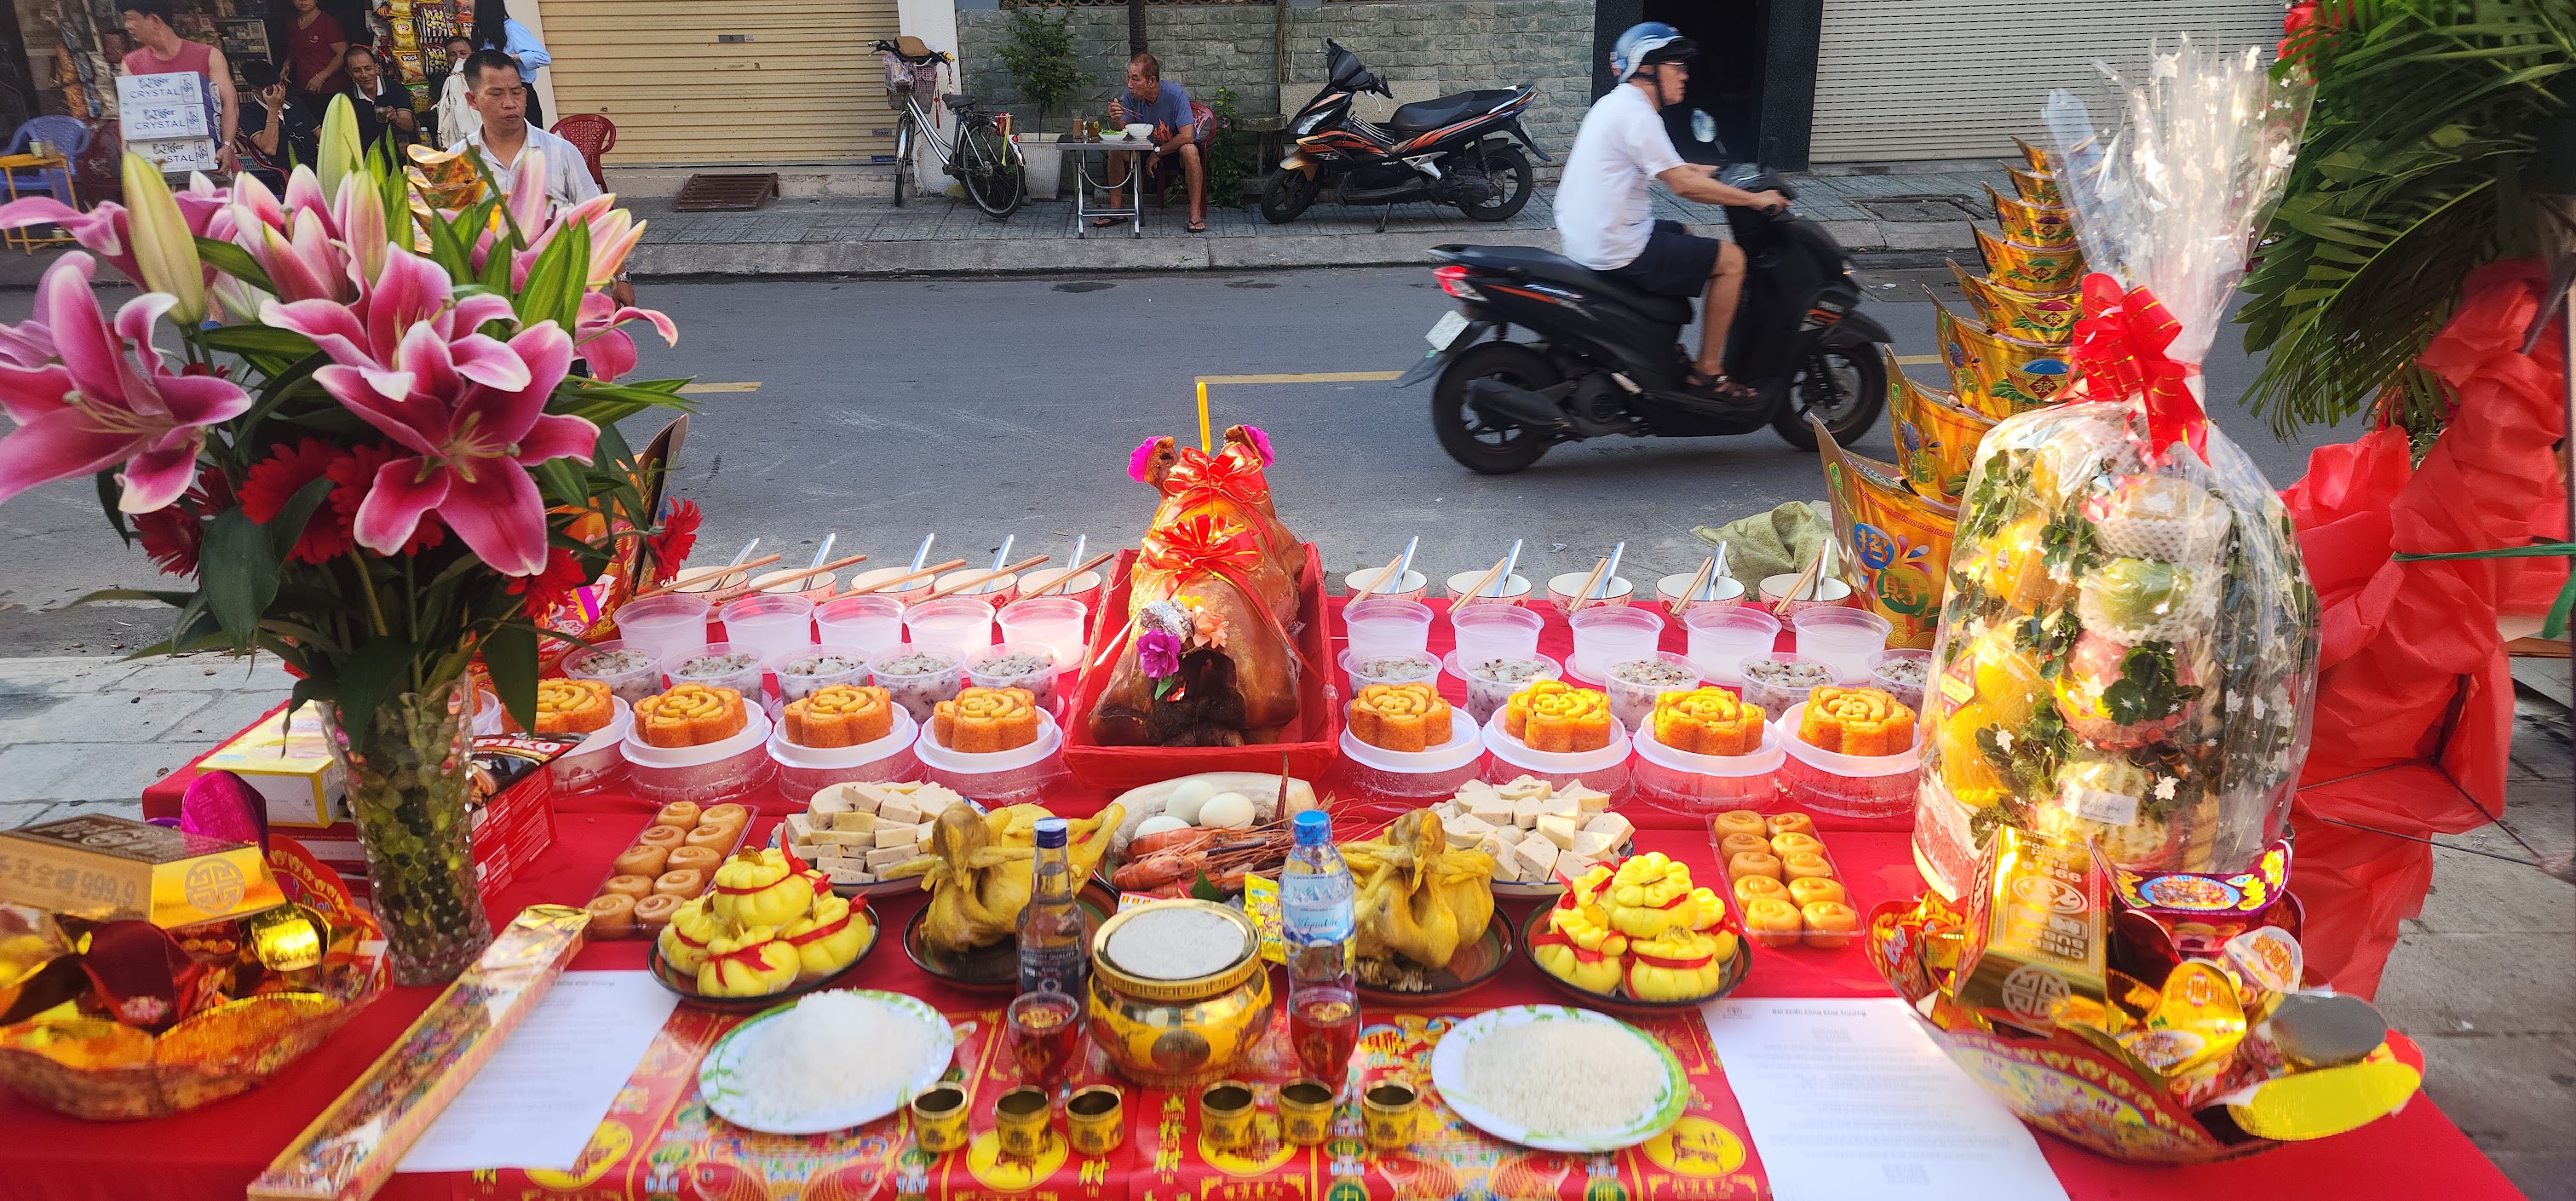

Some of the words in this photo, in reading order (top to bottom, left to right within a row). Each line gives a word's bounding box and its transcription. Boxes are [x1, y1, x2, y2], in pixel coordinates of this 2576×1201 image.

[129, 89, 181, 99] CRYSTAL
[152, 108, 175, 119] Tiger
[135, 120, 186, 129] CRYSTAL
[162, 142, 185, 153] Tiger
[144, 155, 195, 164] CSTAL
[2034, 380, 2053, 394] 發
[1858, 528, 1889, 562] 招
[1881, 574, 1927, 606] 財
[474, 738, 561, 753] PIKO
[2021, 860, 2083, 883] 999.9
